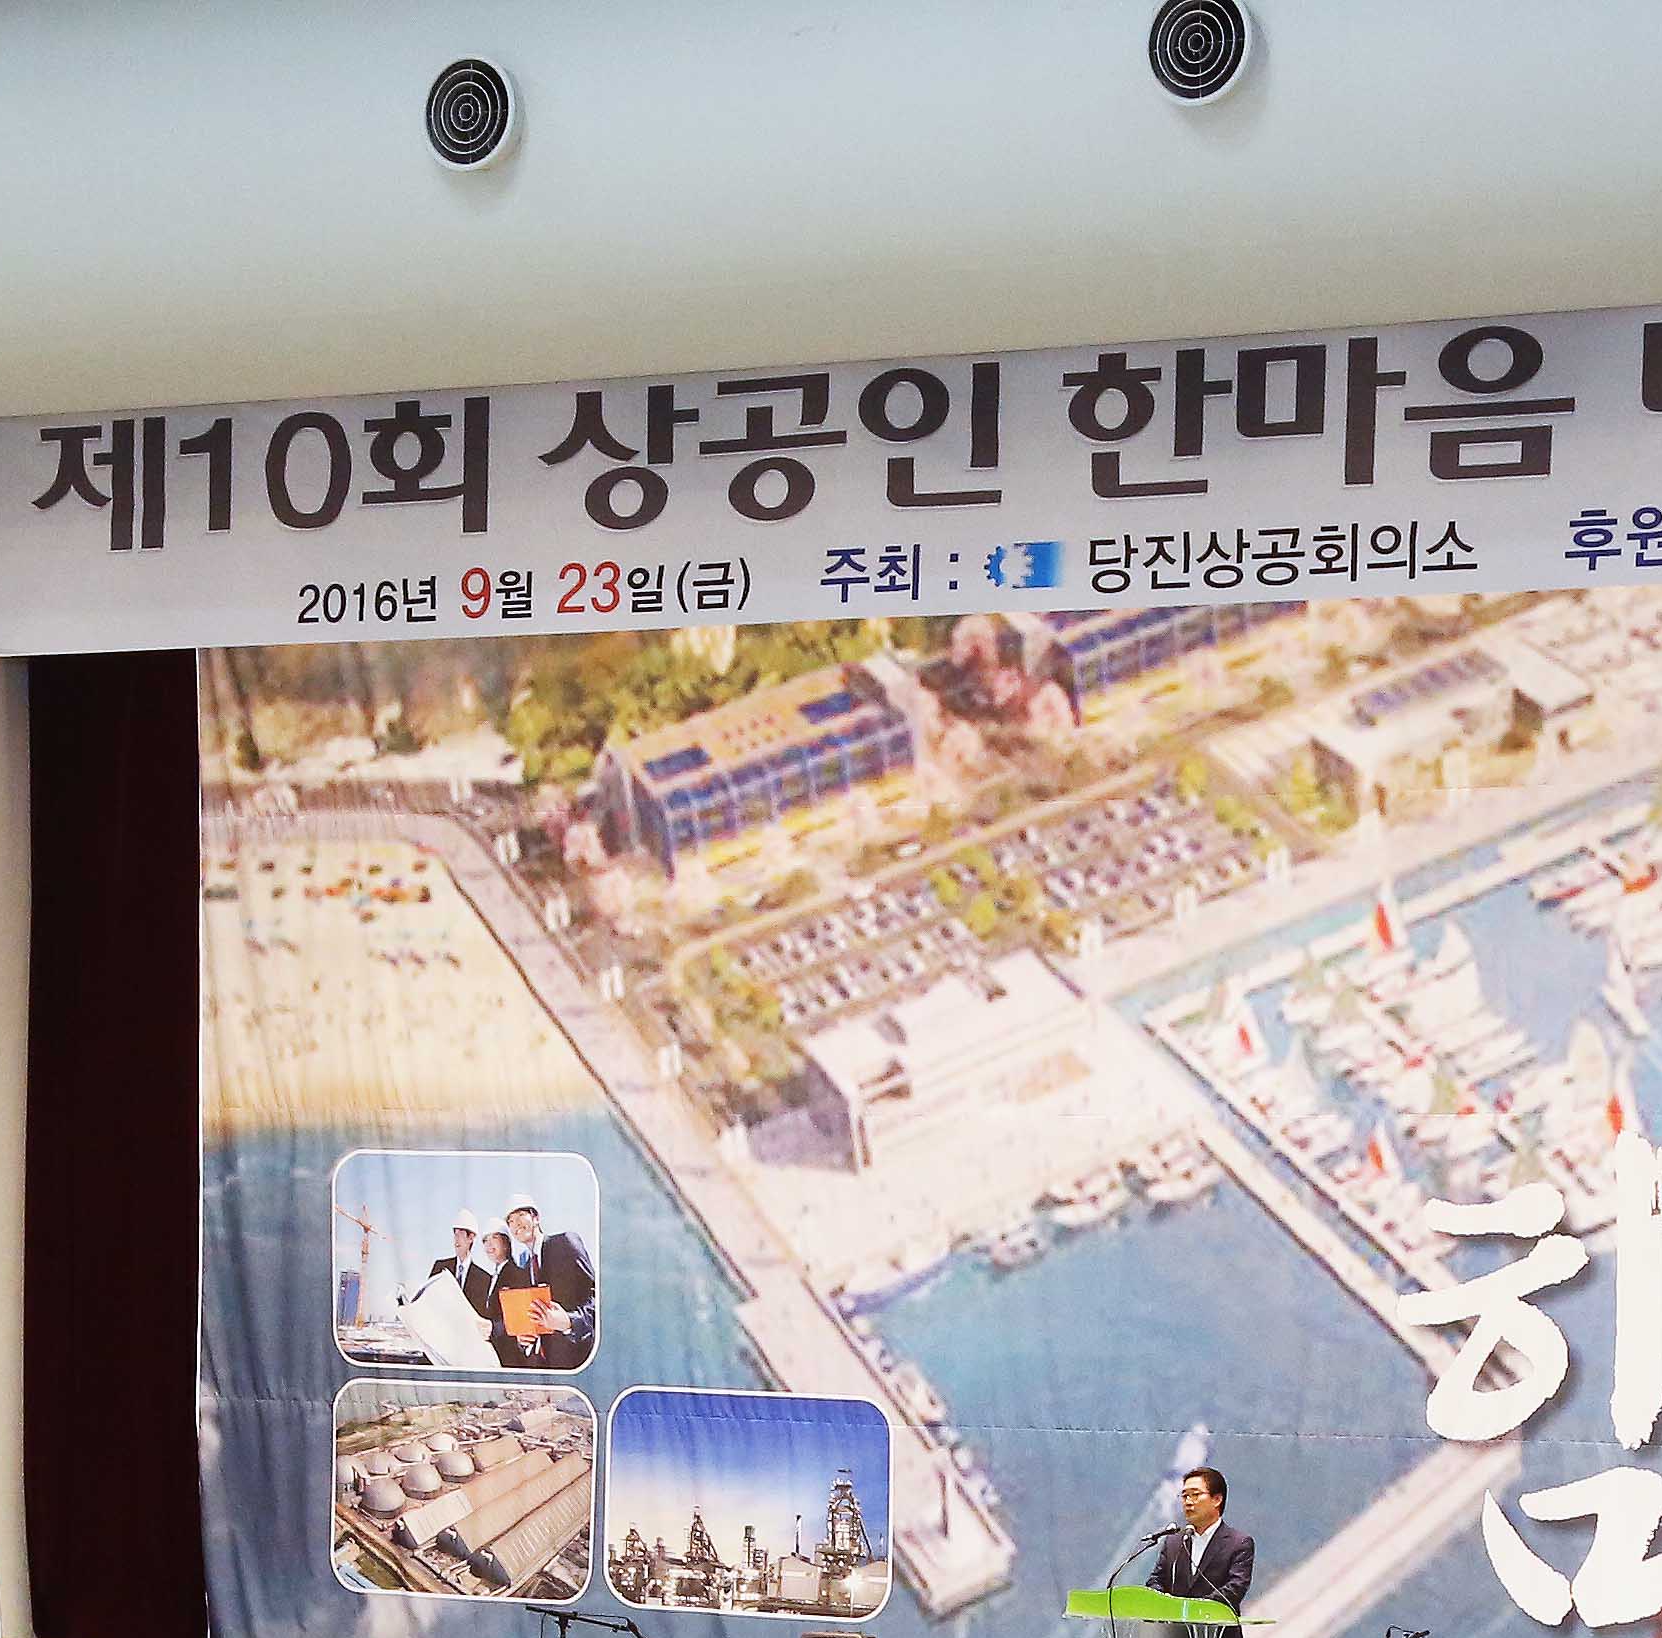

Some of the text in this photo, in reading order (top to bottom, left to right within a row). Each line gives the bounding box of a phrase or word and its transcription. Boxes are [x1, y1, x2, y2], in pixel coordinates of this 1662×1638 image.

[31, 396, 491, 552] 제10회
[537, 362, 1004, 532] 상공인
[1062, 325, 1577, 500] 한마음
[297, 575, 438, 625] 2016년
[461, 567, 534, 620] 9월
[556, 557, 752, 615] 23일(금)
[1088, 517, 1482, 595] 당진상공회의소
